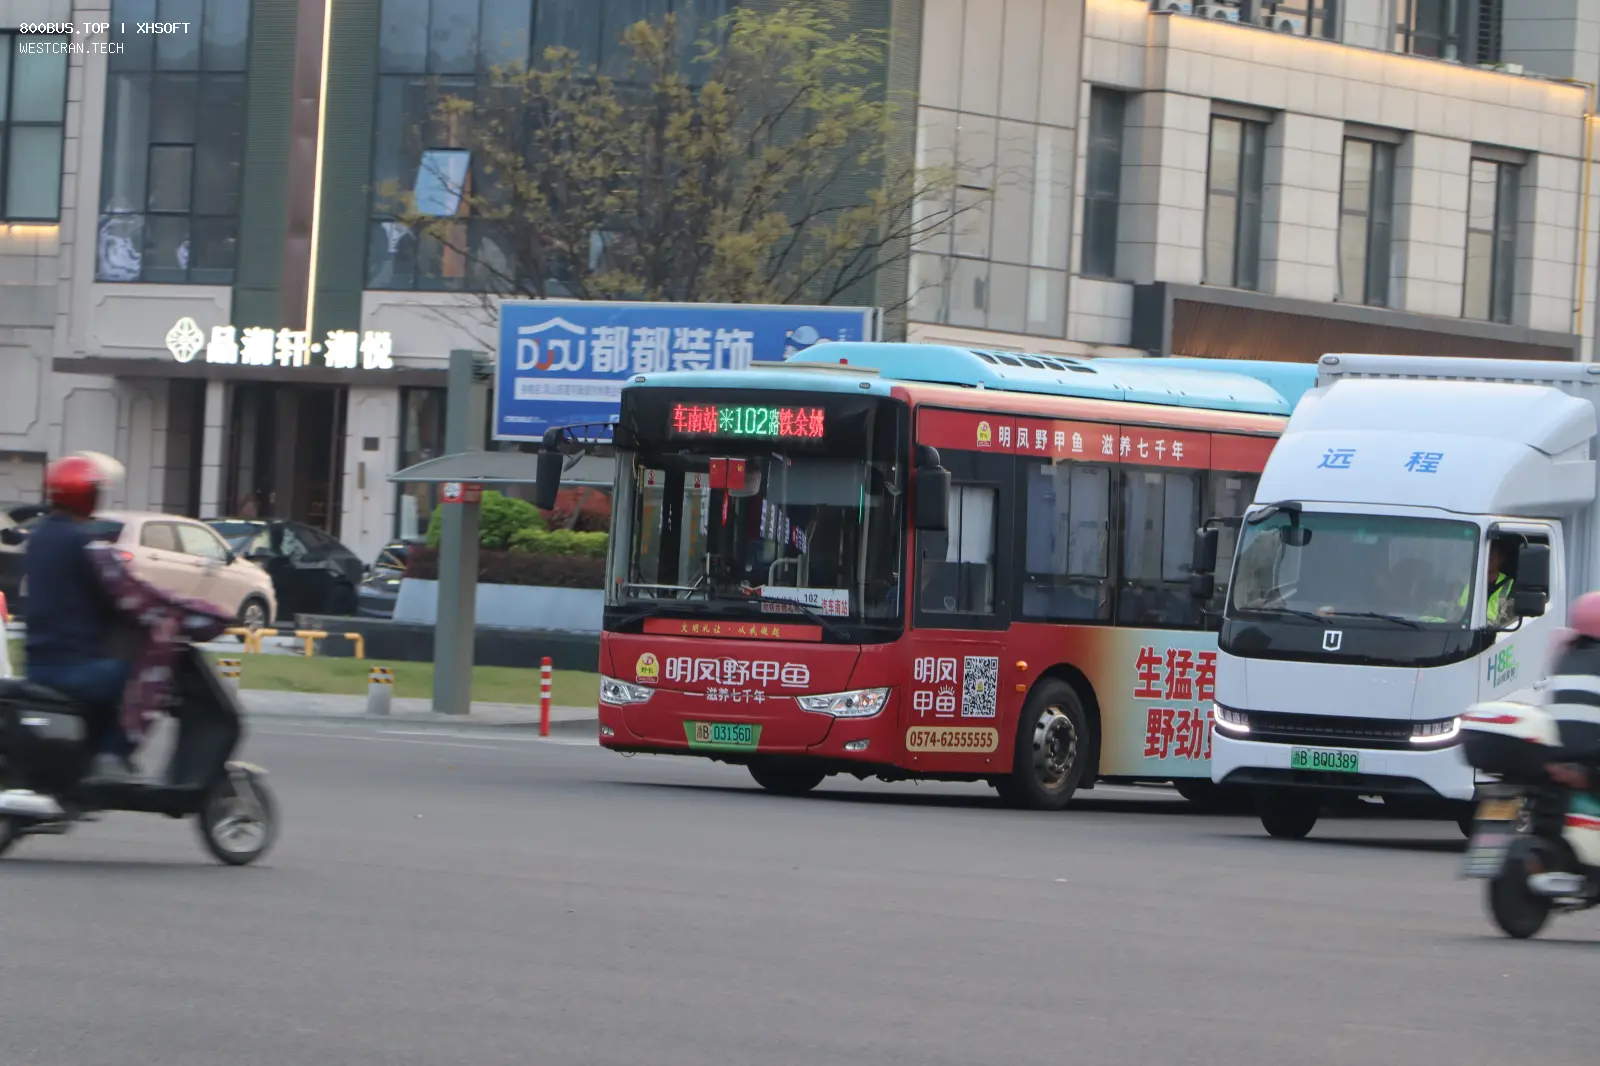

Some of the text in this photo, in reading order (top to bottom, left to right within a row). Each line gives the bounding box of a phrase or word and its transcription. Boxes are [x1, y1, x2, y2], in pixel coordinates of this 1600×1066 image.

[590, 325, 754, 373] 都都装饰
[998, 424, 1184, 461] 明凤野甲鱼 滋养七千年
[1316, 448, 1444, 474] 远程
[803, 594, 818, 603] 102
[821, 598, 848, 615] 汽车南站
[665, 656, 811, 689] 明凤野甲鱼
[913, 656, 957, 685] 明凤
[706, 686, 766, 705] 滋养七千年
[913, 685, 956, 718] 甲鱼
[909, 731, 993, 748] 0574-62555555
[1143, 706, 1215, 761] 野劲
[1313, 751, 1357, 769] BQ0389
